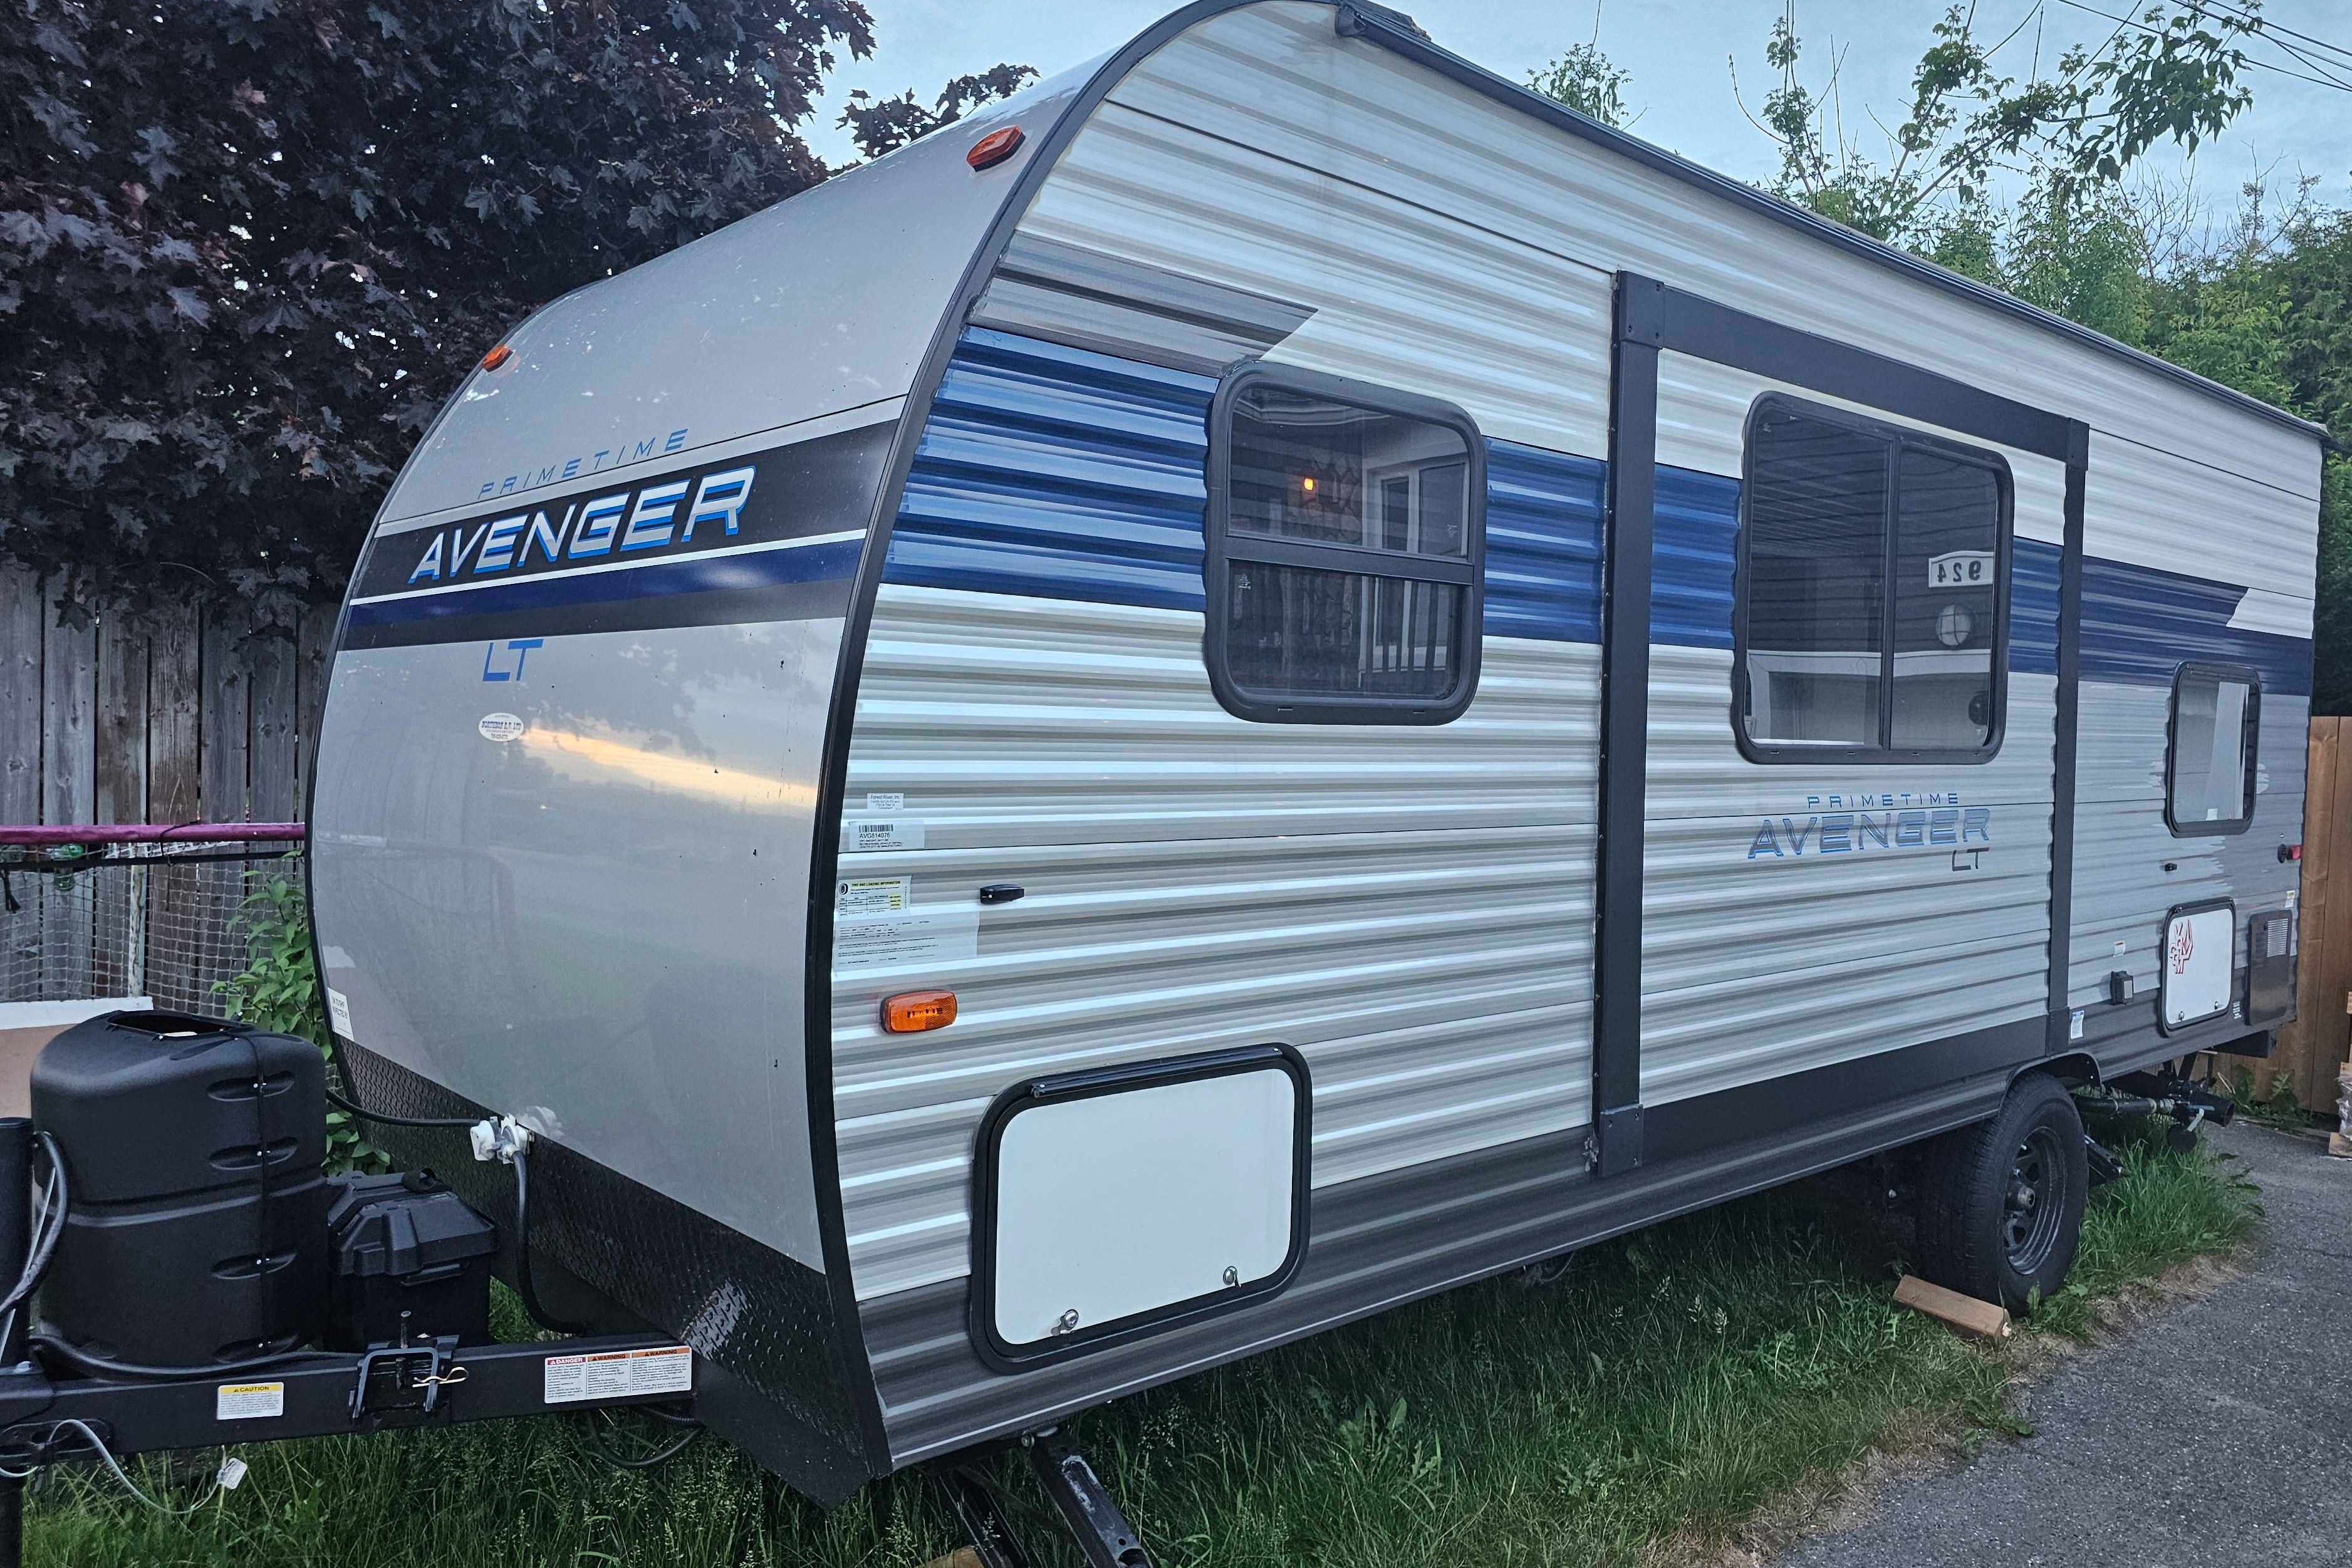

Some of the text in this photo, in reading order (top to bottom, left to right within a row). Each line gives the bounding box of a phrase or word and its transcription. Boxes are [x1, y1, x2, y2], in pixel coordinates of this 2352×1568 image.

[477, 428, 689, 500] PRIMETIME
[408, 465, 757, 584] AVENGER
[482, 638, 544, 682] LT
[1807, 792, 1959, 809] PRIMETIME
[1747, 808, 1990, 859] AVENGER
[1952, 847, 1990, 872] LT
[556, 1357, 583, 1365] DANGER
